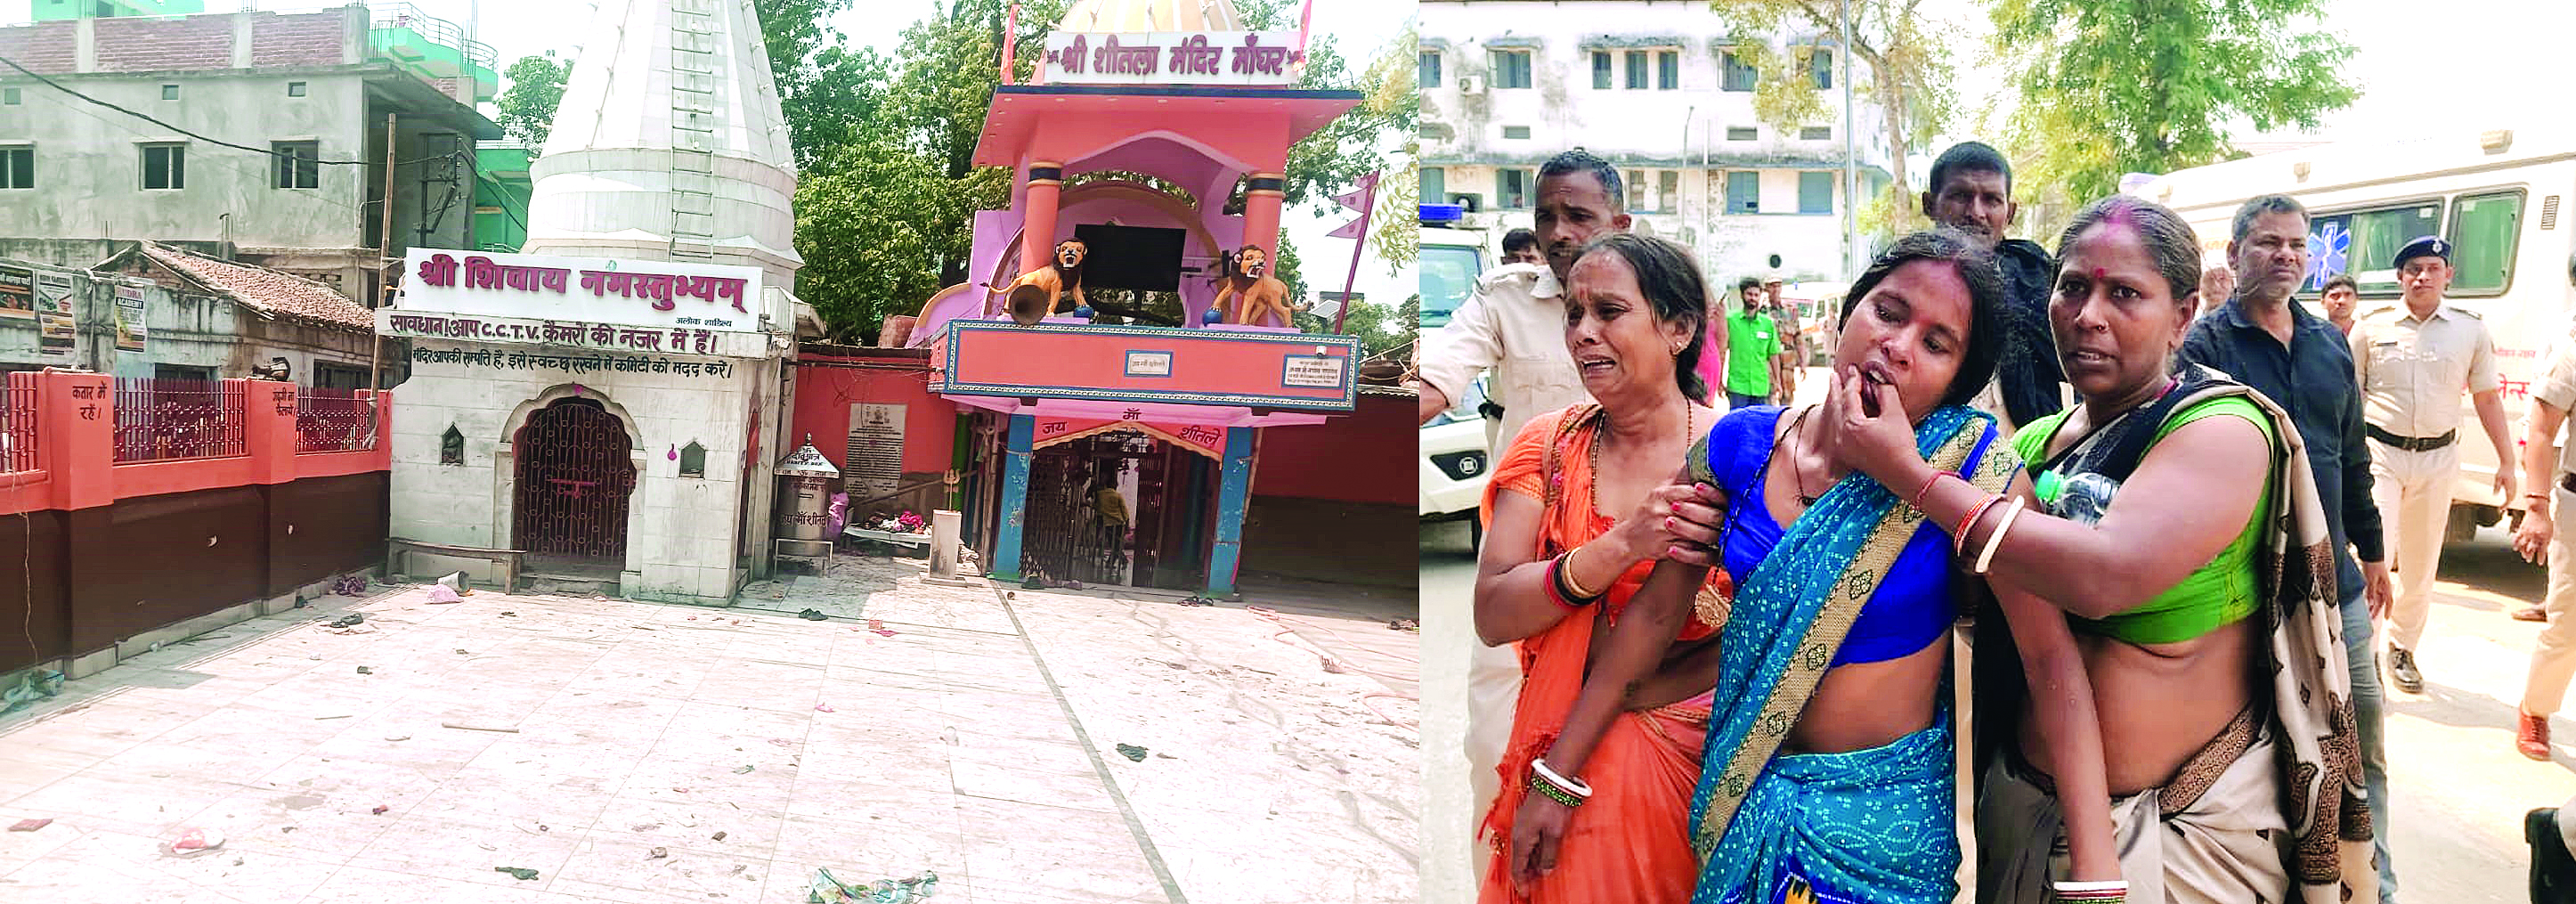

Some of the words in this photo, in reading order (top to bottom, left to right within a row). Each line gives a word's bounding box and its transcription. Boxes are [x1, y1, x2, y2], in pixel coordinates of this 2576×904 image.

[1060, 34, 1087, 74] श्री
[1093, 34, 1160, 76] शीतला
[1169, 34, 1223, 76] मंदिर
[418, 254, 459, 287] श्री
[464, 256, 571, 294] शिवाय
[580, 270, 749, 314] नमस्तुभ्यम्
[449, 319, 481, 338] आप
[591, 323, 615, 346] की
[620, 329, 663, 352] नजर
[670, 328, 689, 350] में
[508, 350, 526, 371] इसे
[652, 357, 670, 374] को
[673, 362, 702, 377] मदद
[72, 386, 94, 400] कतार
[1042, 421, 1068, 435] जय
[1123, 408, 1142, 420] माँ
[1178, 425, 1221, 446] शीतले
